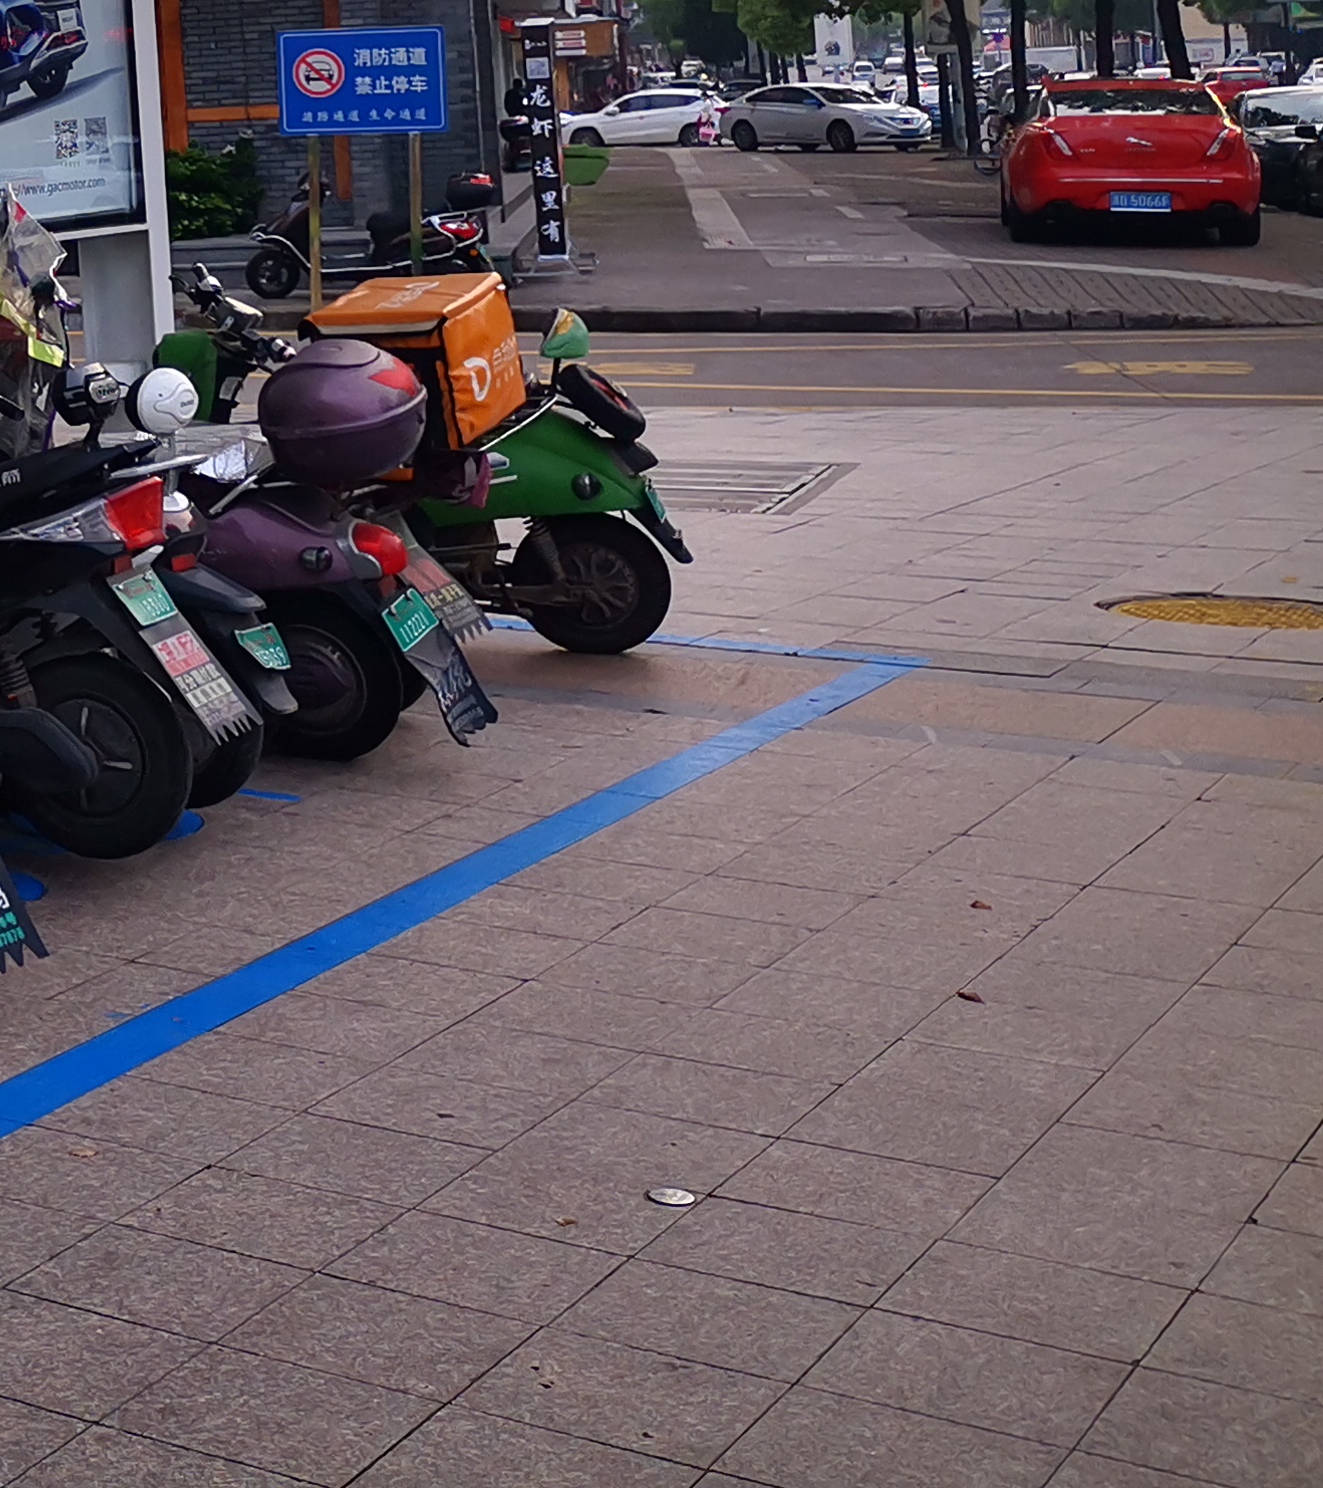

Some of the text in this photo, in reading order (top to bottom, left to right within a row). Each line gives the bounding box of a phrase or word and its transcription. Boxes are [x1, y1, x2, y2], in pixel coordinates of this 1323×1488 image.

[353, 46, 428, 68] 消防通道
[354, 74, 429, 96] 禁止停车
[529, 84, 563, 244] 龙虾这里有
